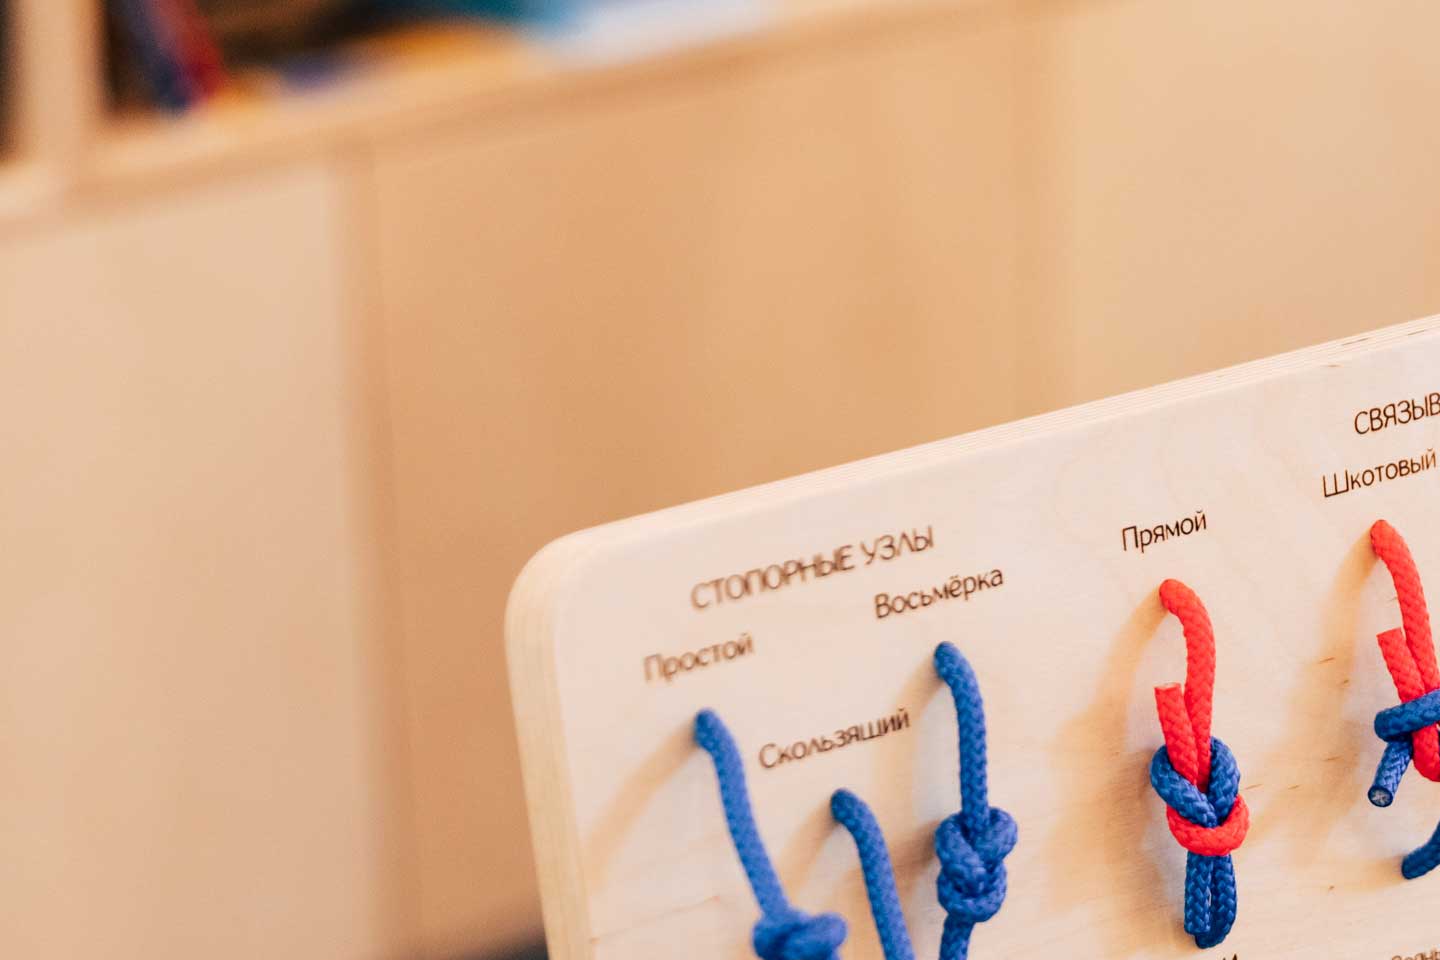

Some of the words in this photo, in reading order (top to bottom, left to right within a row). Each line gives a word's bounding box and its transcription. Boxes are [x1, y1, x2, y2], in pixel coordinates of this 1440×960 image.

[1322, 449, 1437, 499] Шкотовый
[1121, 511, 1208, 554] Прямой
[690, 545, 854, 612] СТОПОРНЫЕ
[860, 526, 935, 567] УЗЛЫ
[874, 567, 1004, 620] Восьмёрка
[642, 632, 755, 683] Простой
[758, 706, 912, 771] Скользящий
